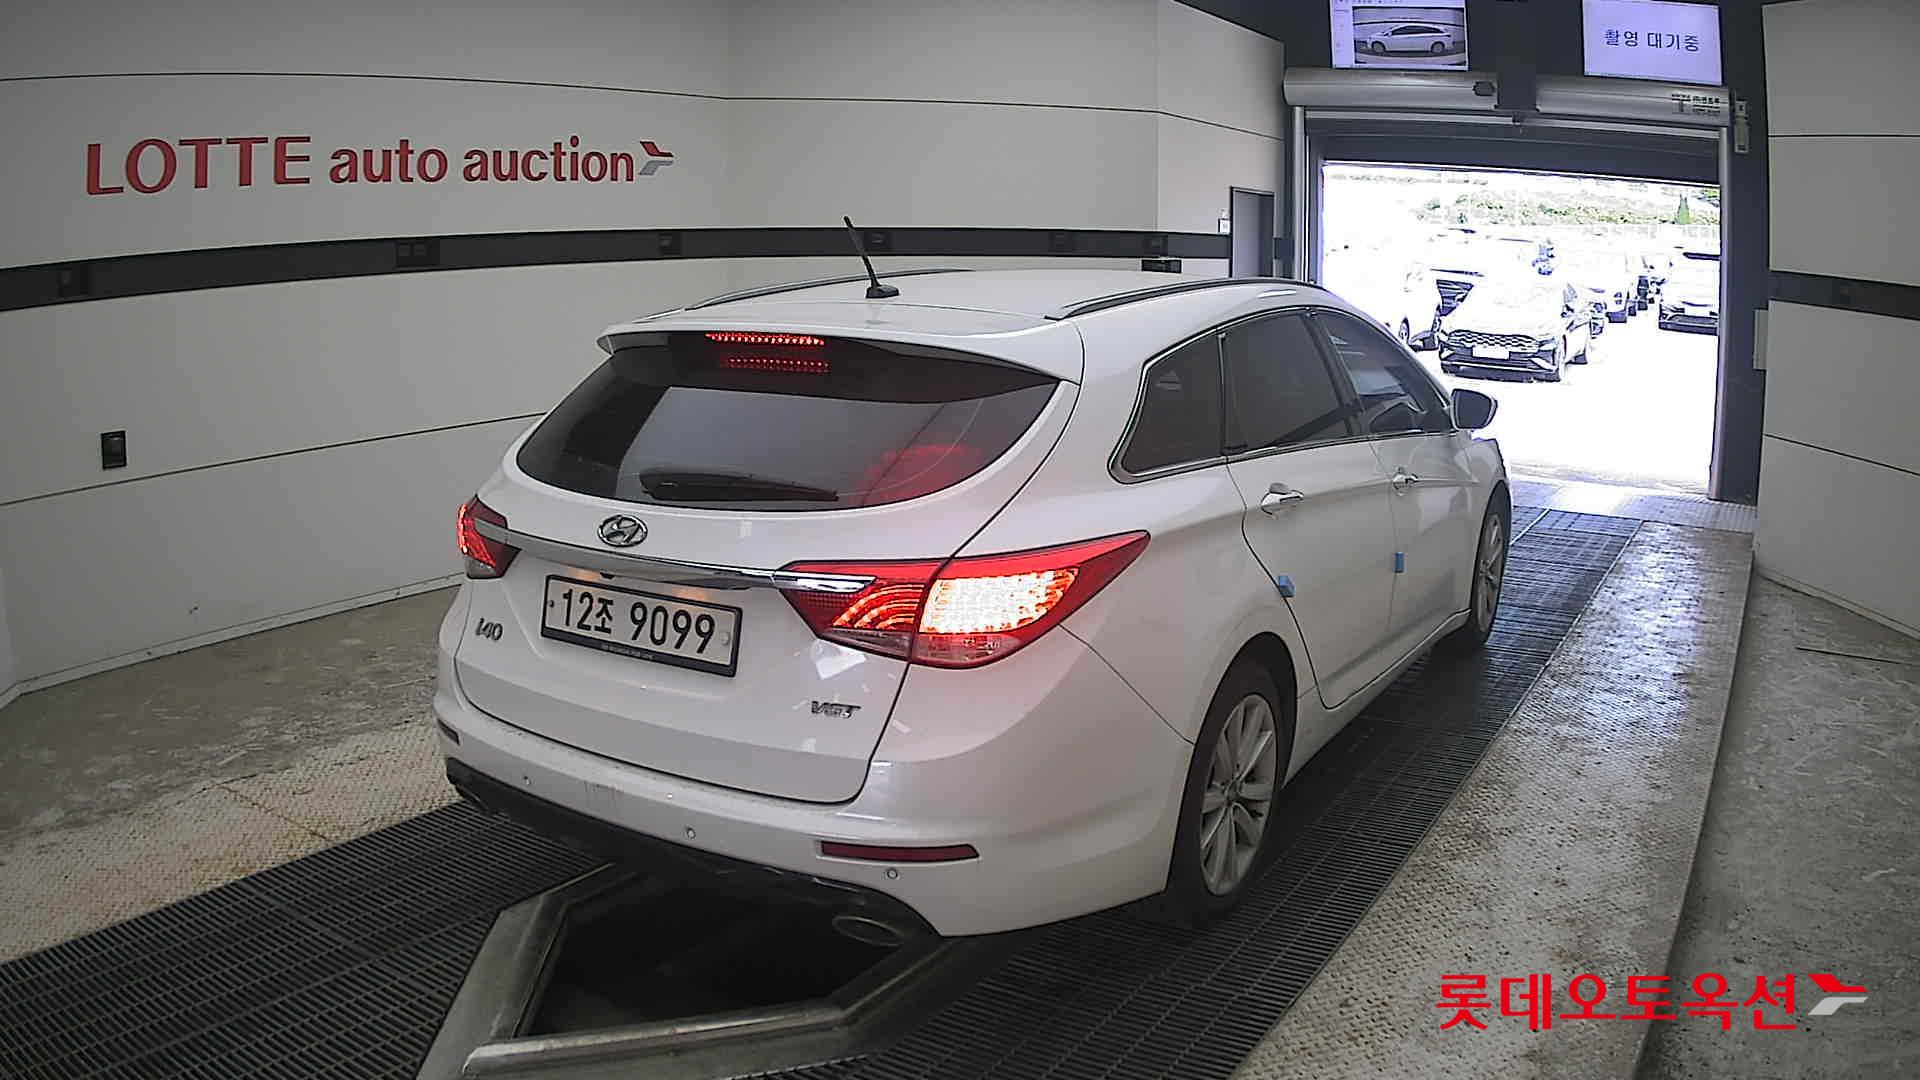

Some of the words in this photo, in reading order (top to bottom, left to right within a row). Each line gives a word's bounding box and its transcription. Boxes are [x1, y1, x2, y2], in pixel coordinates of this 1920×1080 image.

[1603, 29, 1639, 47] 촬영
[1647, 32, 1699, 52] 대기중
[86, 136, 311, 195] LOTTE
[329, 139, 448, 183] auto
[463, 135, 634, 182] auction
[562, 588, 614, 634] 12조
[630, 601, 715, 654] 9099
